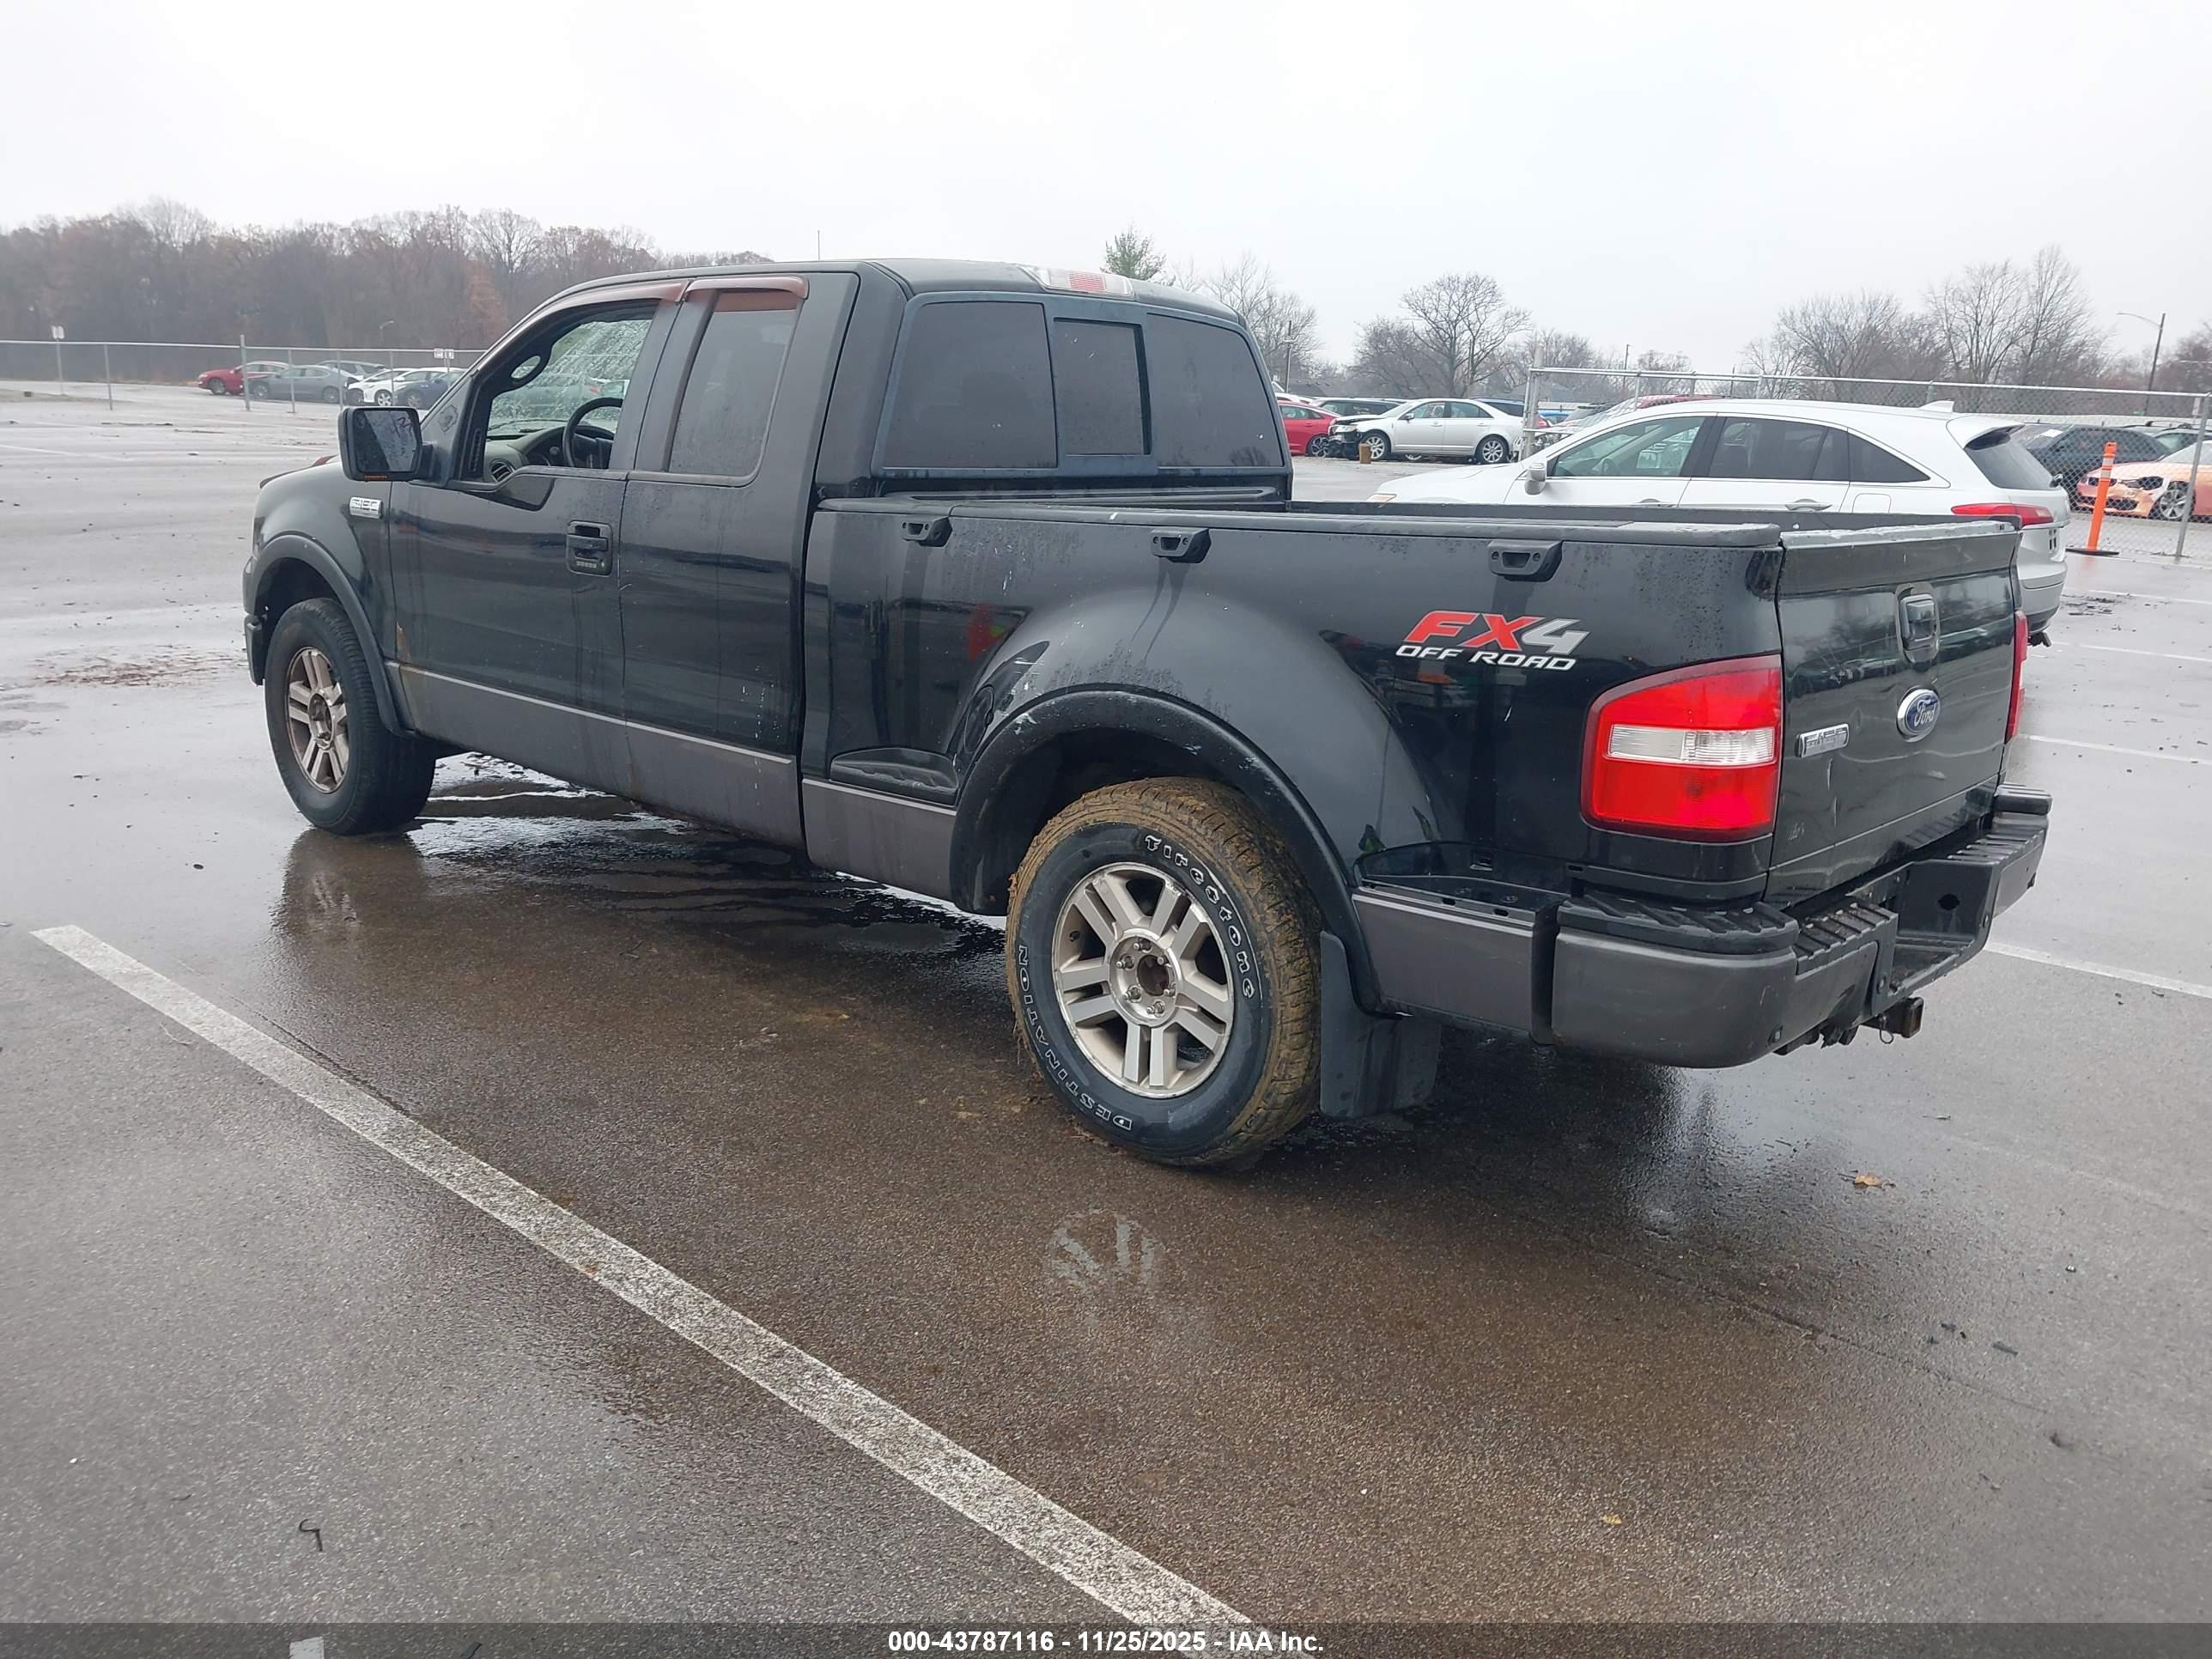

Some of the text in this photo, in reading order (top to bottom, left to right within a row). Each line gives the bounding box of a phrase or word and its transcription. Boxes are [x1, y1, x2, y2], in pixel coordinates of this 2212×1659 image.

[1403, 609, 1590, 656] FX4
[1395, 644, 1577, 672] OFF ROAD
[1913, 699, 1937, 727] Ford
[1145, 834, 1256, 999] Firestone
[1018, 945, 1133, 1131] DESTINATION
